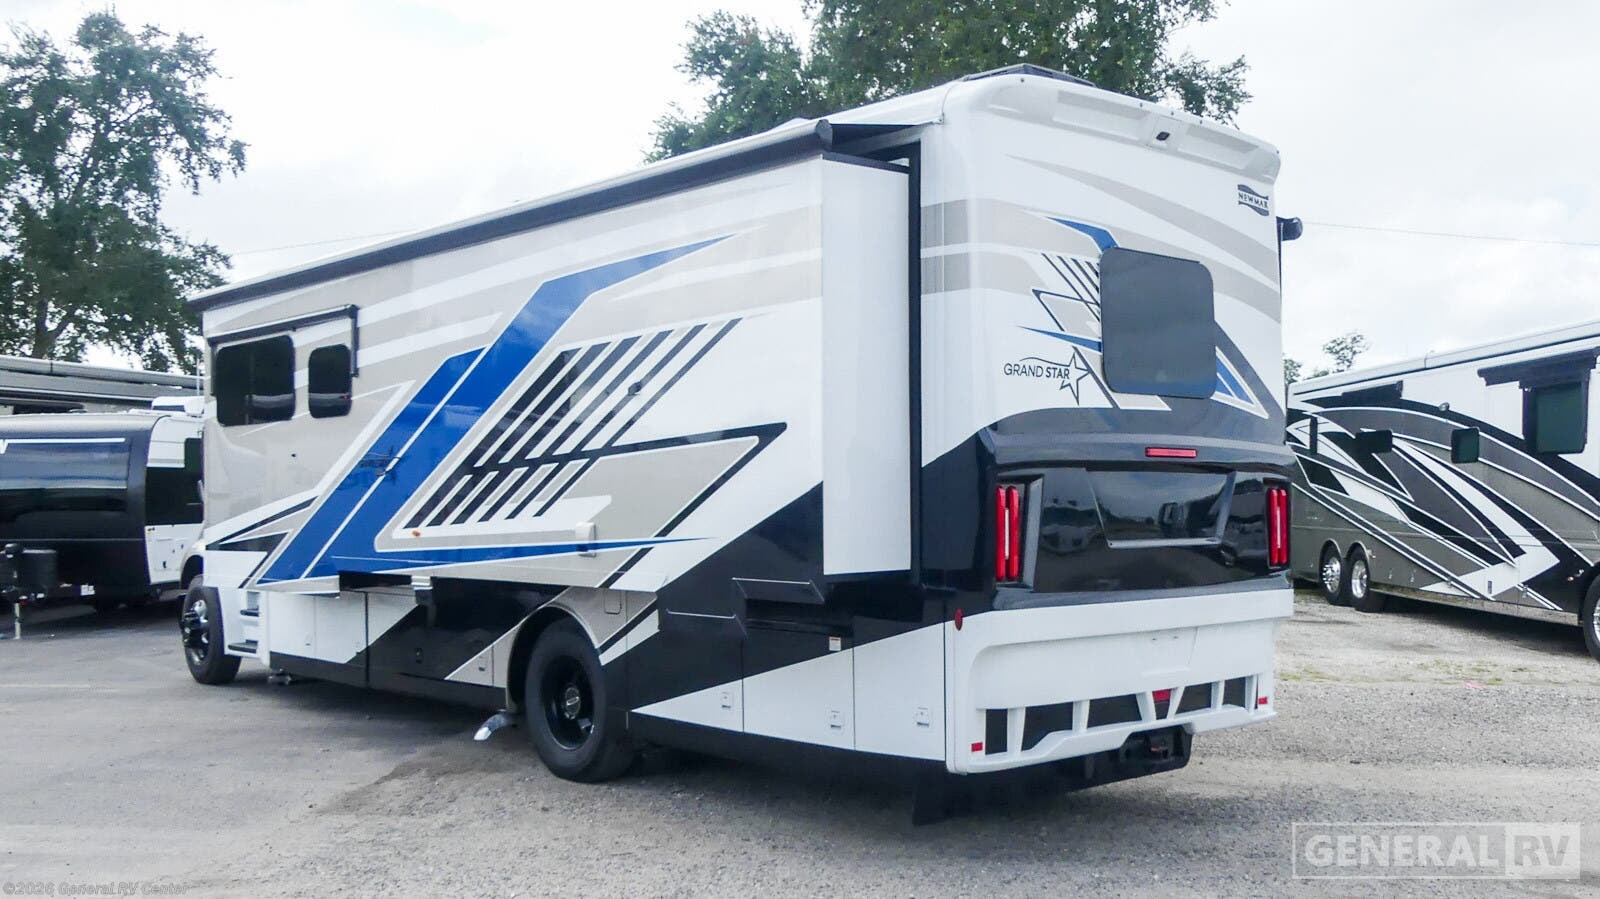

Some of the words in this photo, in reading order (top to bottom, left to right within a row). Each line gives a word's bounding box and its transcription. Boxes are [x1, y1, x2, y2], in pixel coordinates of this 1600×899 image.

[1238, 191, 1268, 208] NEWMAR
[1003, 362, 1044, 378] GRAND
[1045, 366, 1071, 380] STAR
